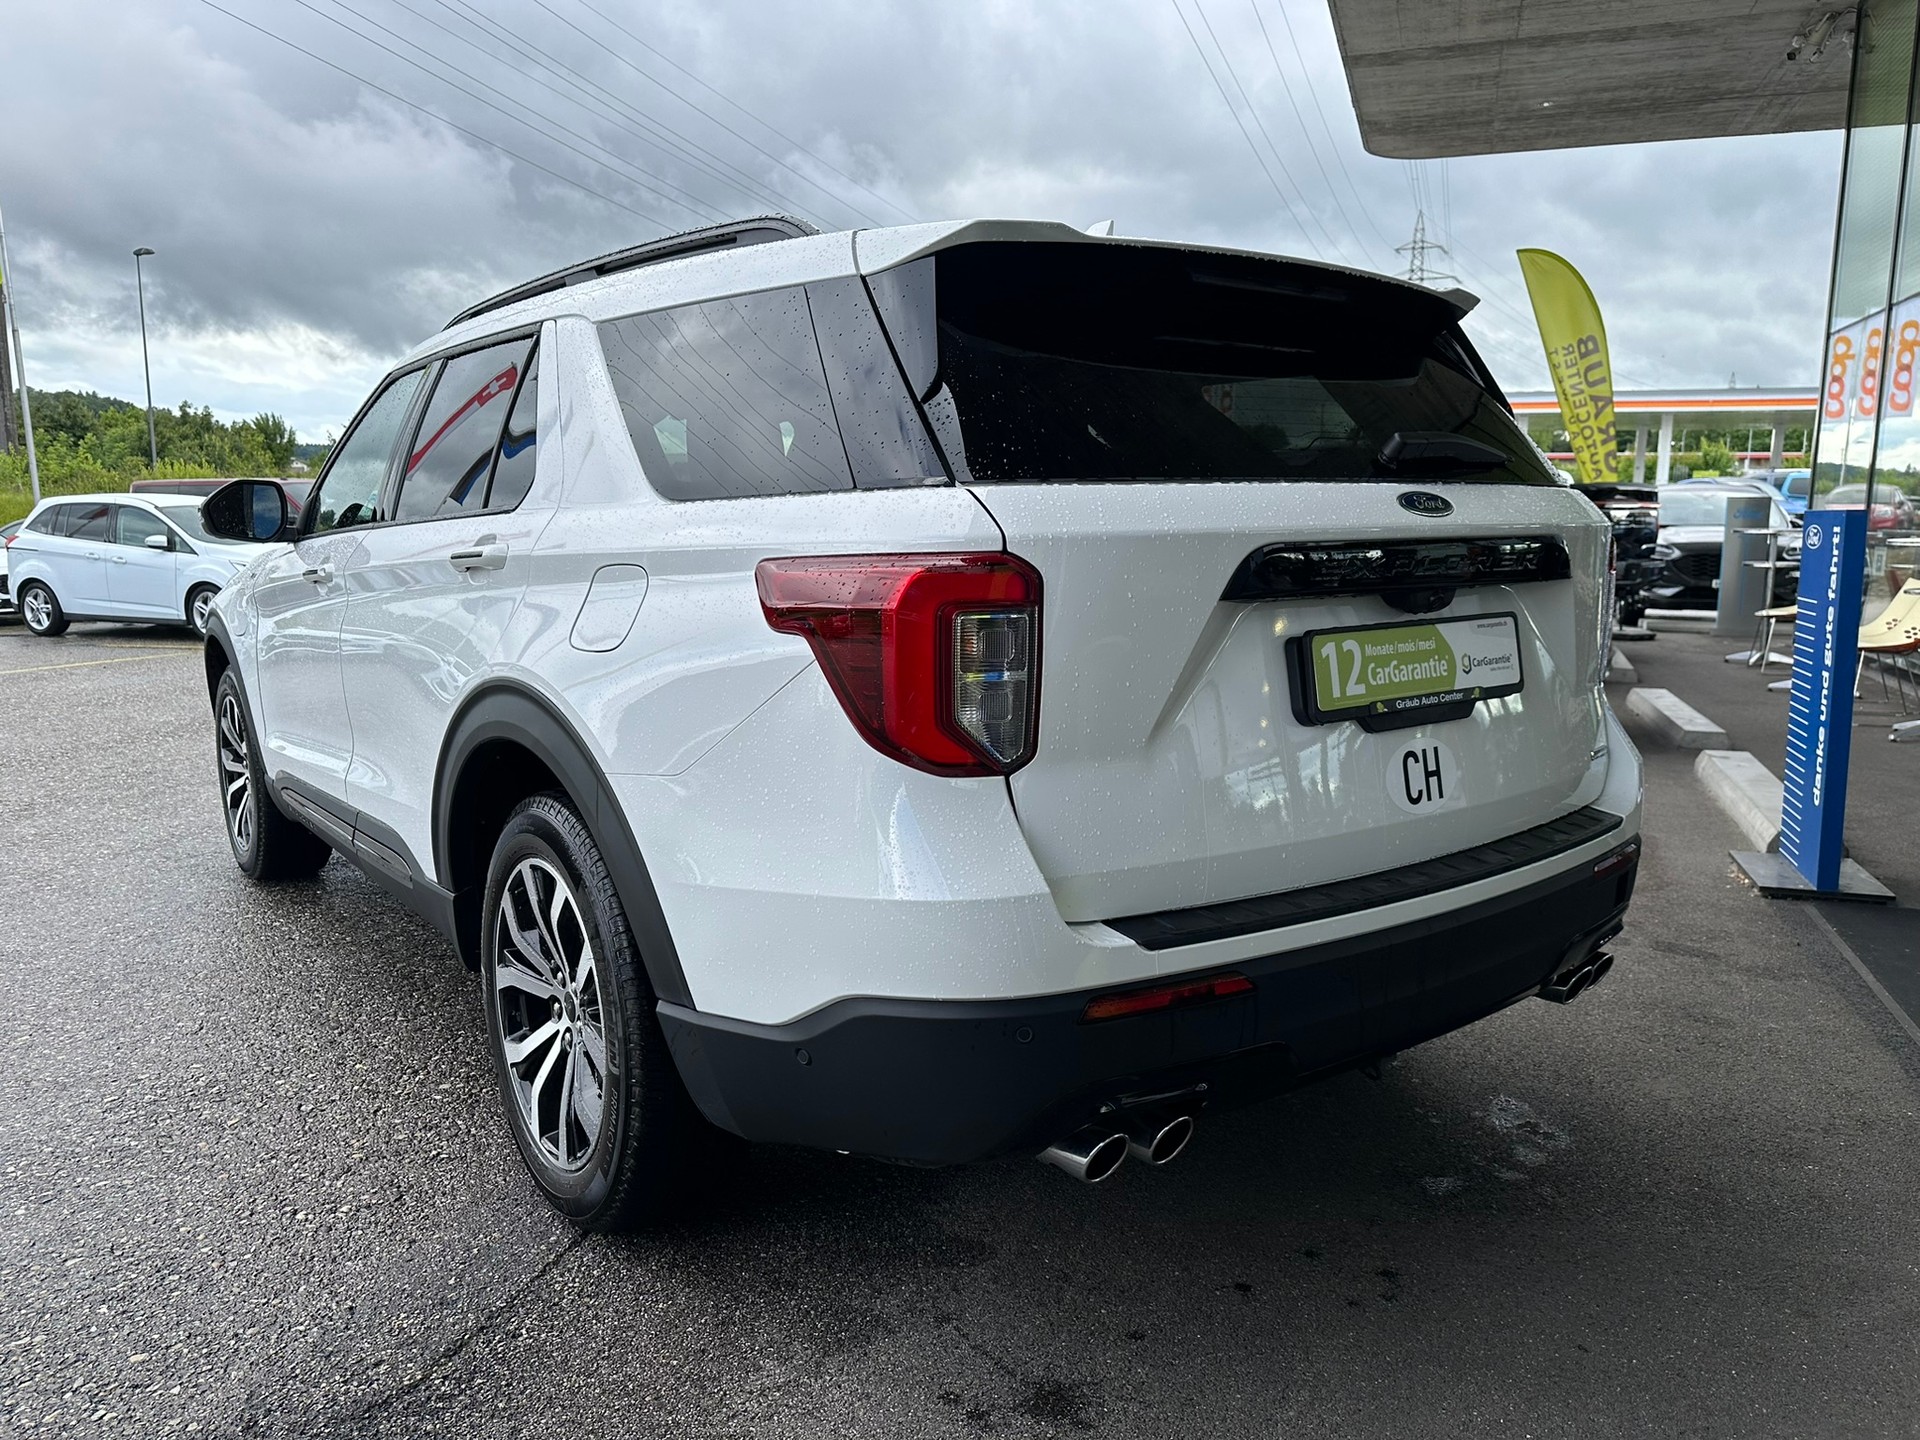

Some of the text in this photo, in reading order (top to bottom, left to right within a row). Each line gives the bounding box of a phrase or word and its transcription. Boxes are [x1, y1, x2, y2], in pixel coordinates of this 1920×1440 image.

[1320, 639, 1366, 698] 12
[1364, 637, 1436, 657] Monate/mois/mesi
[1813, 526, 1841, 807] danke und gute fahrt!
[1396, 692, 1464, 709] Gräub Auto Center
[1402, 746, 1444, 805] CH
